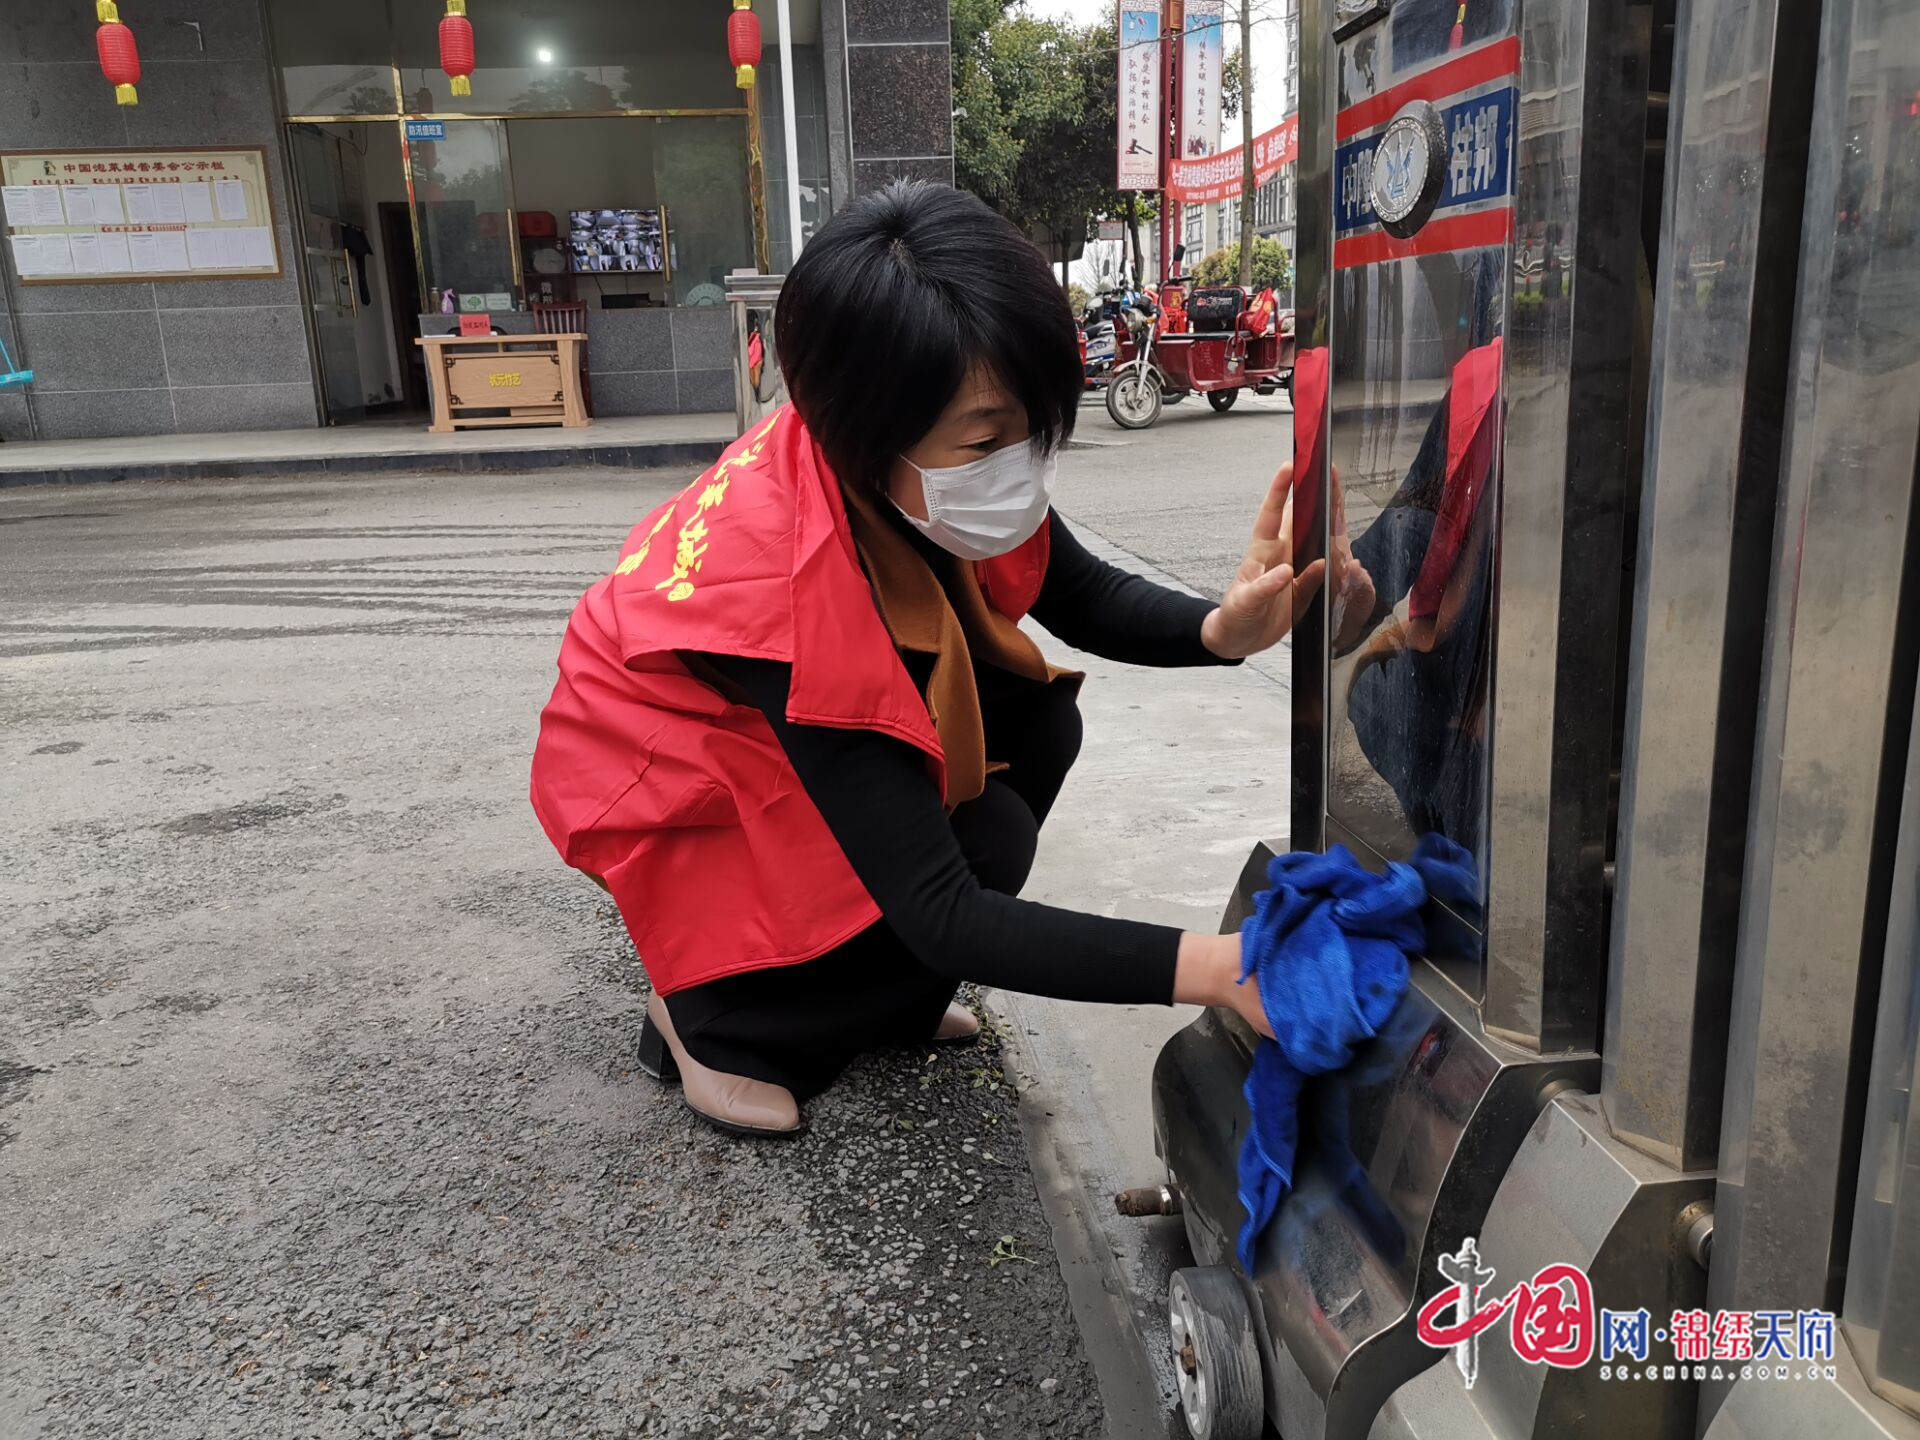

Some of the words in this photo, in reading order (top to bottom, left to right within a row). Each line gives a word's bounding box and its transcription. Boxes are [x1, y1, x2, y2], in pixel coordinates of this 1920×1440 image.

[63, 160, 225, 173] 中国泡菜城管委会公示栏
